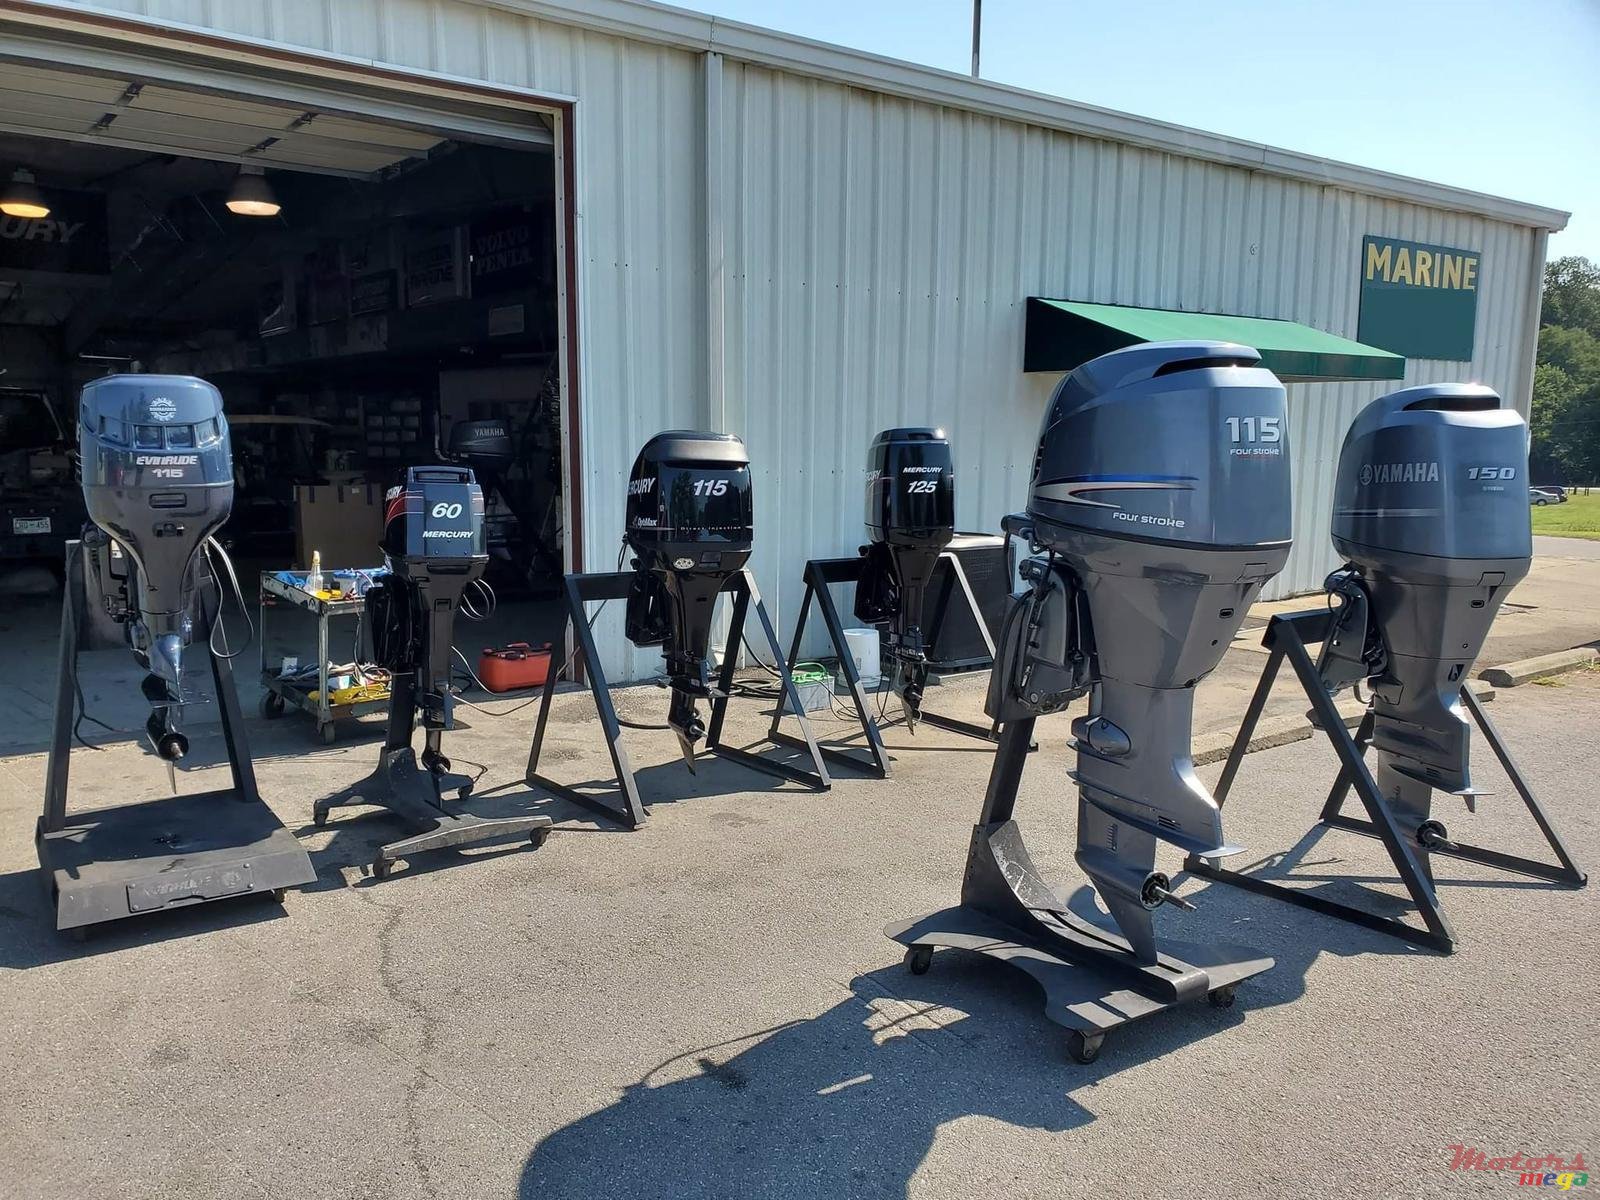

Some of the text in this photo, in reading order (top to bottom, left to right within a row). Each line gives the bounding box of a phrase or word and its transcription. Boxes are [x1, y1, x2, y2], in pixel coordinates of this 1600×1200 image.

[1366, 242, 1477, 290] MARINE
[474, 428, 505, 437] YAMAHA
[1225, 417, 1280, 443] 115
[136, 455, 198, 466] EVINRUDE
[152, 469, 184, 478] 115
[902, 466, 943, 474] MERCURY
[1373, 462, 1439, 483] YAMAHA
[1468, 467, 1516, 480] 150
[693, 479, 729, 497] 115
[907, 480, 938, 494] 125
[432, 502, 463, 519] 60
[422, 531, 474, 539] MERCURY
